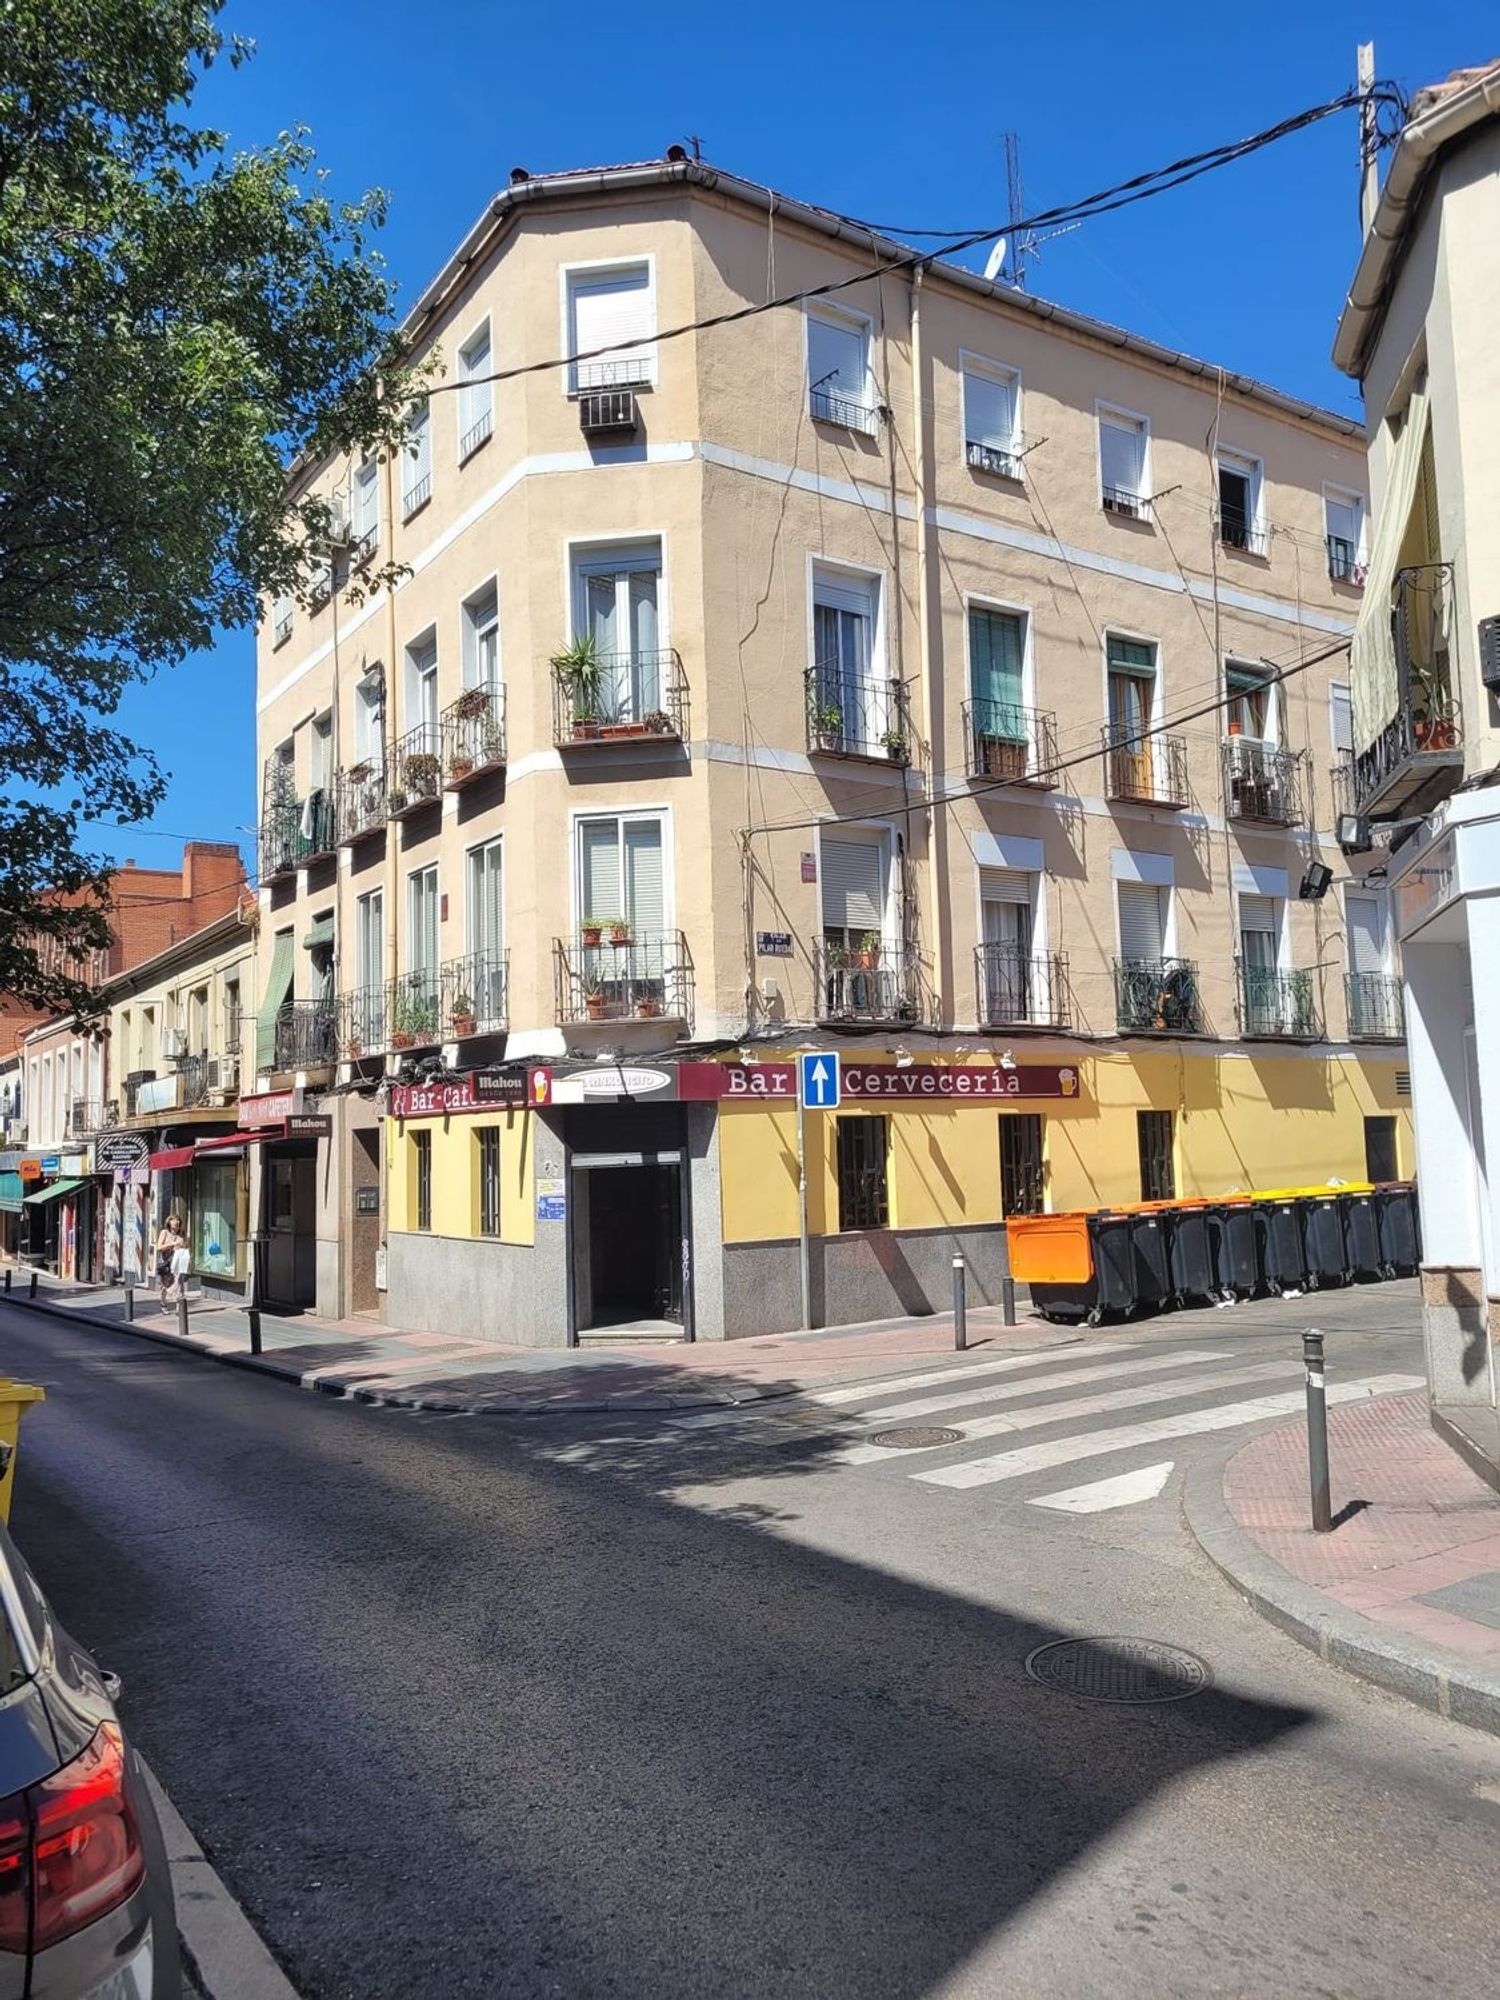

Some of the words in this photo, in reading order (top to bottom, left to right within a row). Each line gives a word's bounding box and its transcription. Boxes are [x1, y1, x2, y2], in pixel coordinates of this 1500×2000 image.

[479, 1076, 523, 1088] Mahou
[728, 1069, 788, 1093] Bar
[845, 1069, 1021, 1094] Cervecería
[291, 1118, 327, 1129] Mahou
